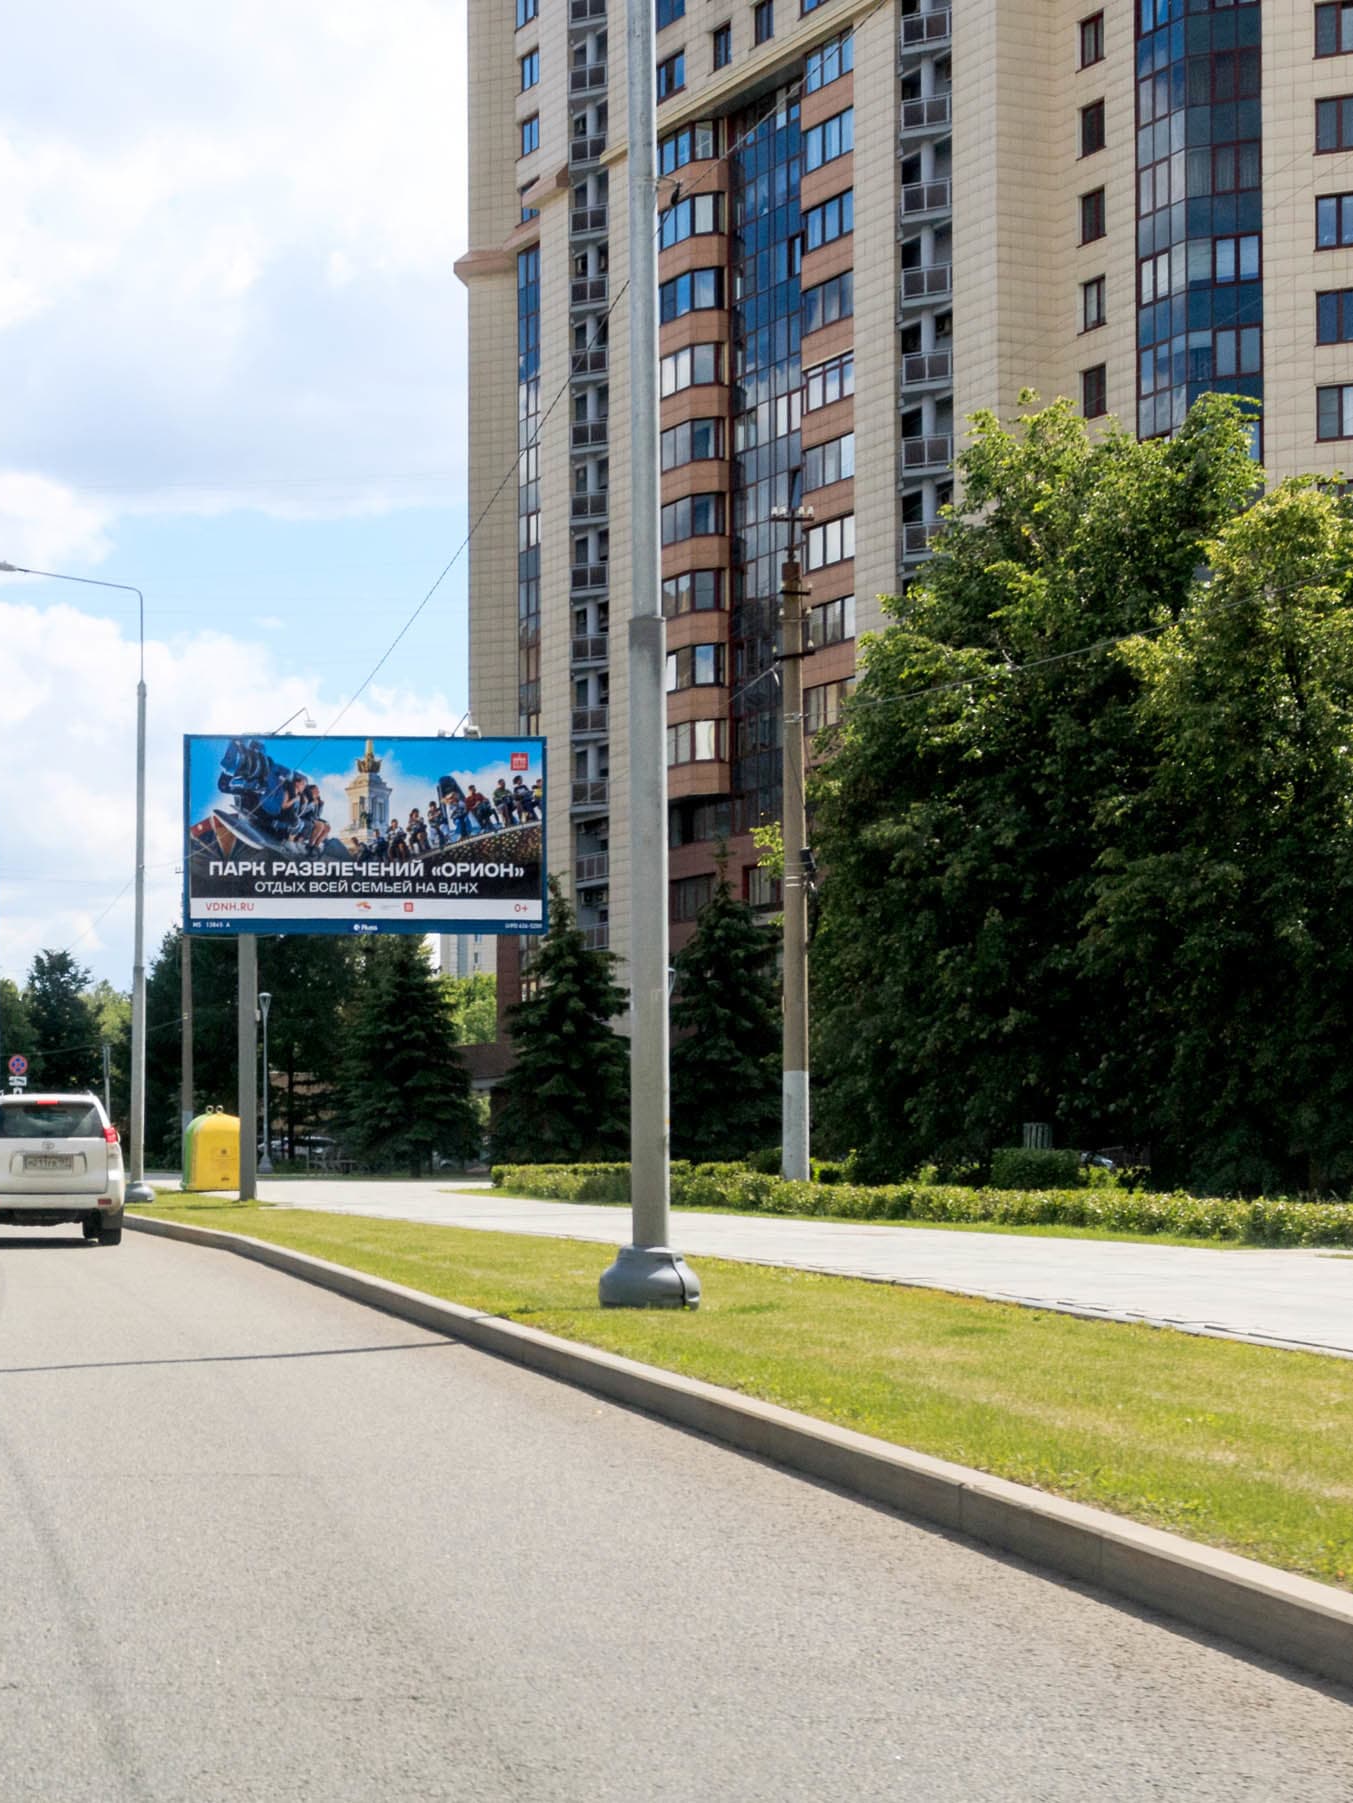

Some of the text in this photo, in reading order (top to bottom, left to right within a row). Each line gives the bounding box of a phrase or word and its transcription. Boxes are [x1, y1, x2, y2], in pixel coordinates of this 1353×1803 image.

[209, 859, 525, 878] ПАРК РАЗВЛЕЧЕНИЙ «ОРИОН»
[254, 880, 479, 895] ОТДЫХ ВСЕЙ СЕМЬЕЙ НА ВДНХ
[205, 902, 255, 911] VDNH.RU
[514, 903, 528, 912] 0+
